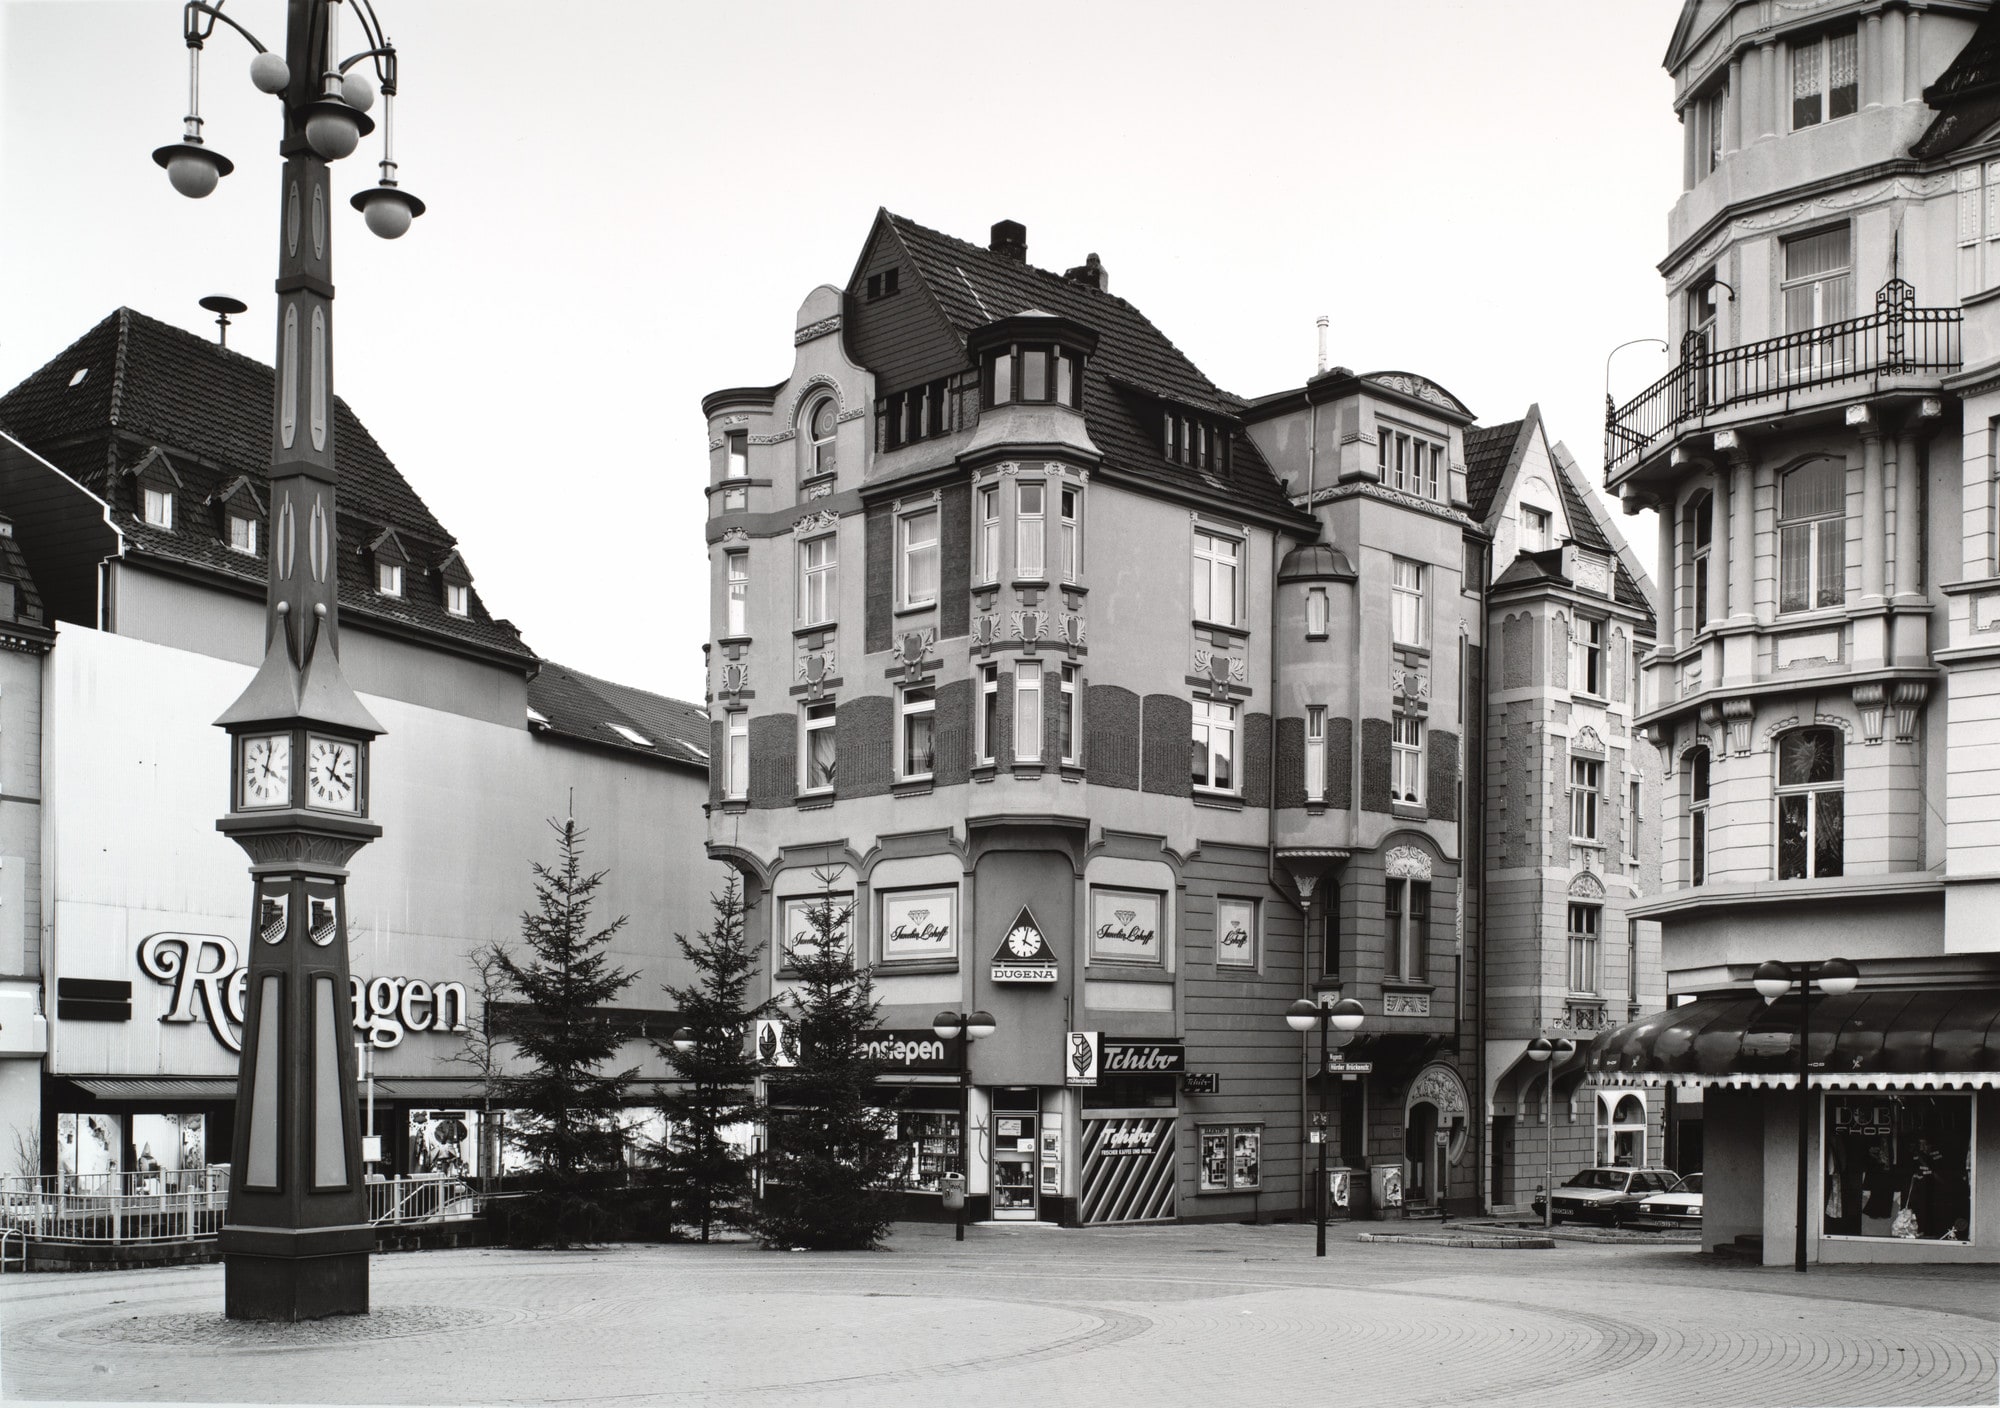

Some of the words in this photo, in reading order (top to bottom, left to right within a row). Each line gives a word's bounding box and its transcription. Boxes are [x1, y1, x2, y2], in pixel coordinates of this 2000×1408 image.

[993, 970, 1055, 979] DUGENA
[1104, 1047, 1179, 1070] Tchibo
[1102, 1128, 1156, 1145] Tchibo
